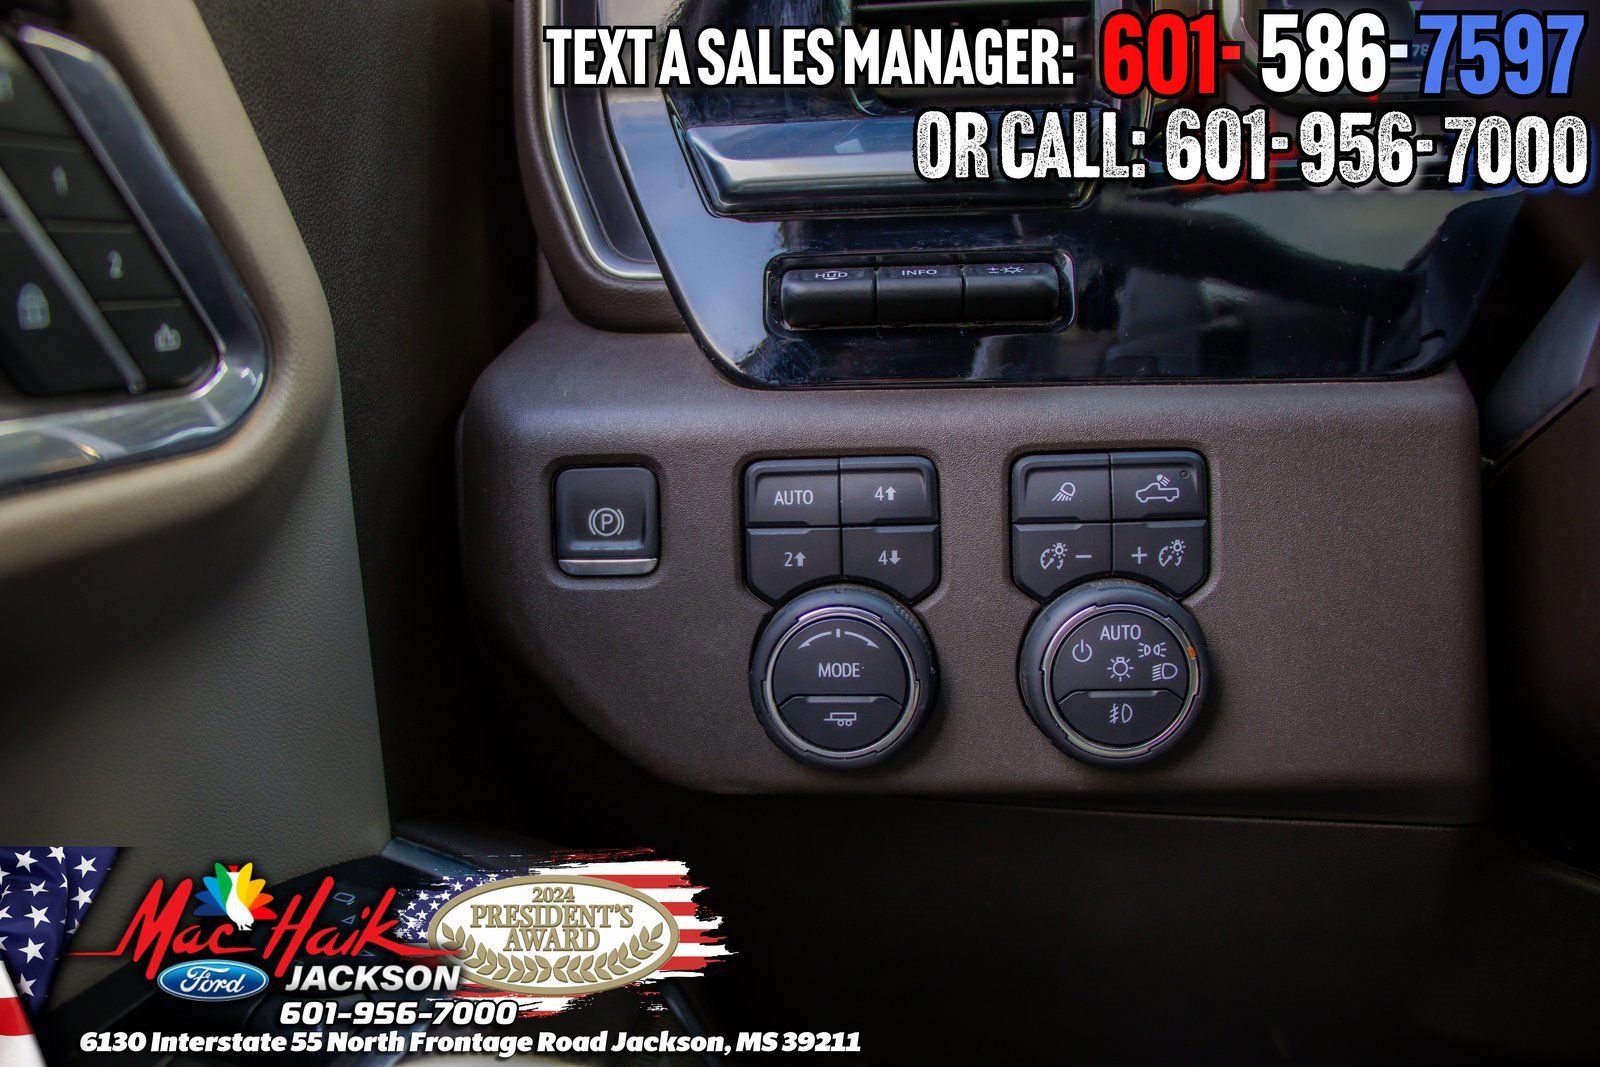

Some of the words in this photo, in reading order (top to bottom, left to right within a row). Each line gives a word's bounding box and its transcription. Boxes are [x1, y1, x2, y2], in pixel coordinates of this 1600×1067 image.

[901, 268, 937, 276] INFO
[774, 490, 814, 505] AUTO
[874, 486, 885, 501] 4
[784, 552, 795, 567] 2
[878, 550, 889, 565] 4
[1100, 624, 1141, 641] AUTO
[817, 662, 860, 678] MODE
